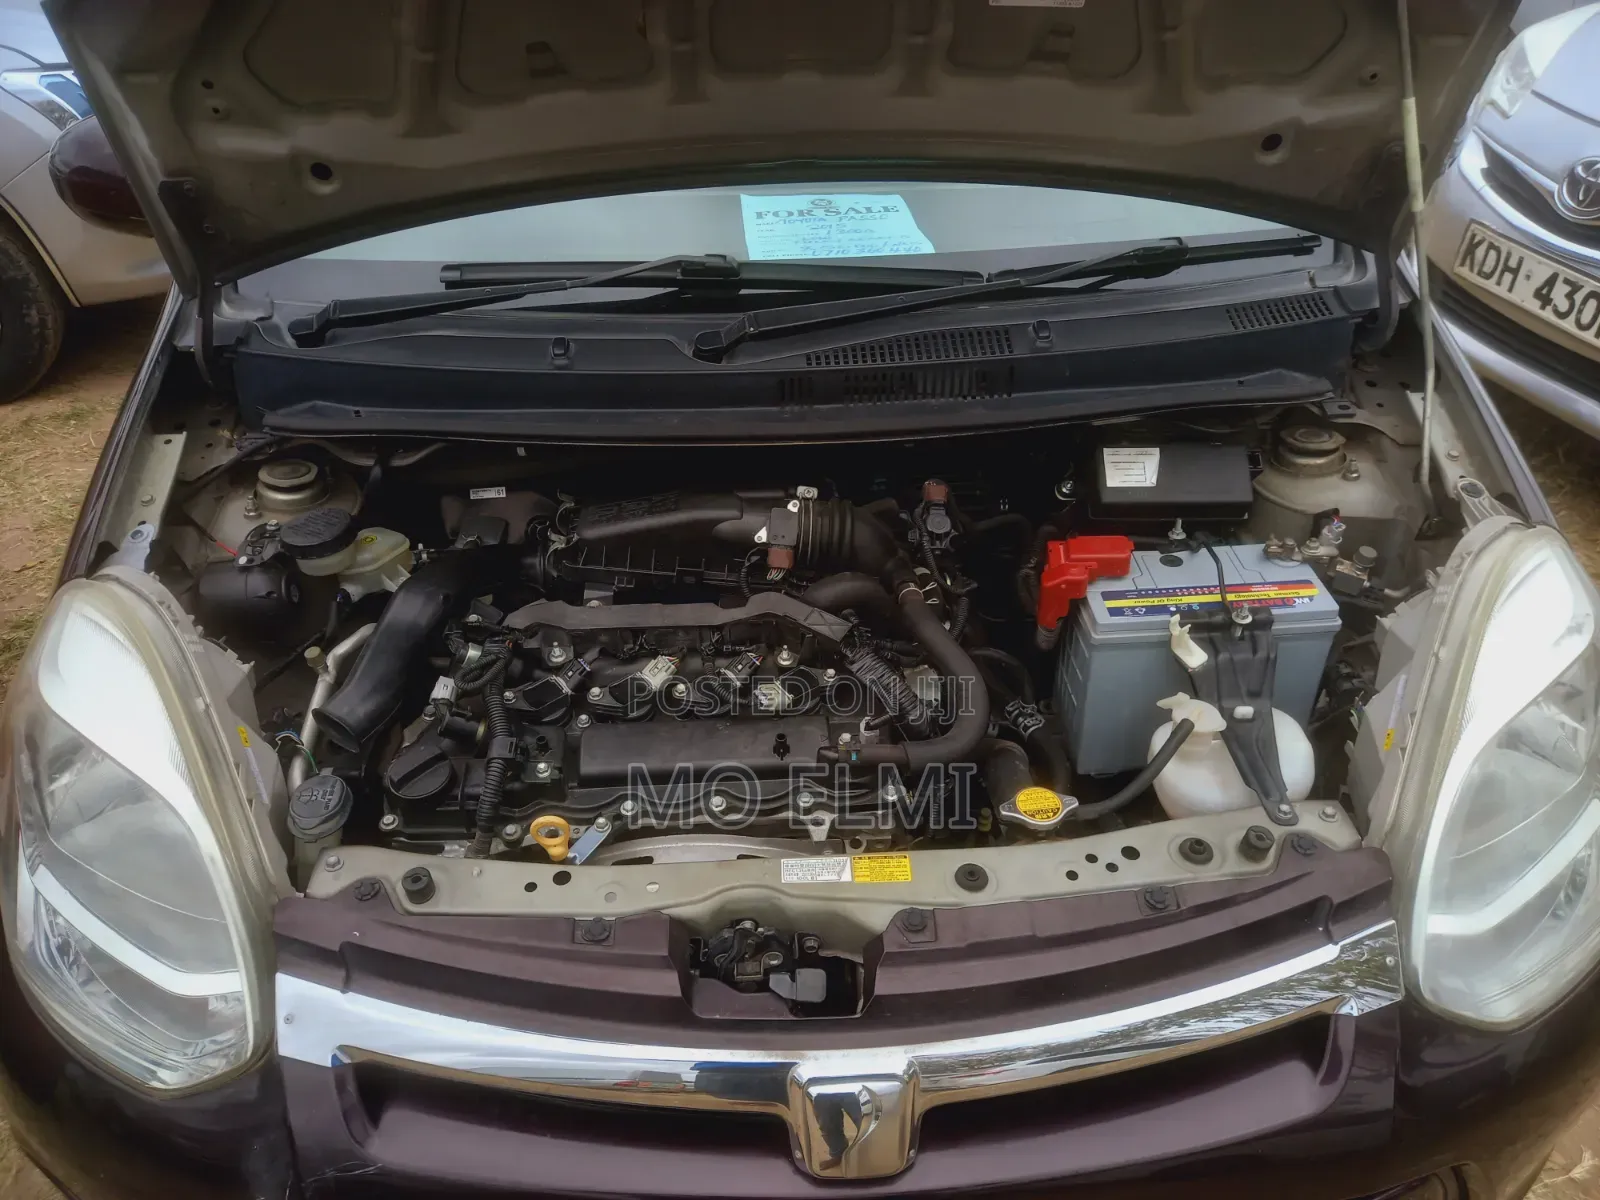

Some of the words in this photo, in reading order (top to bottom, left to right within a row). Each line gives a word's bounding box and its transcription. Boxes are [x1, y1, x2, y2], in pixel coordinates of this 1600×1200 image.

[754, 209, 817, 220] FOR
[823, 205, 899, 216] SALE
[1458, 231, 1524, 294] KDH
[1532, 271, 1600, 340] 430
